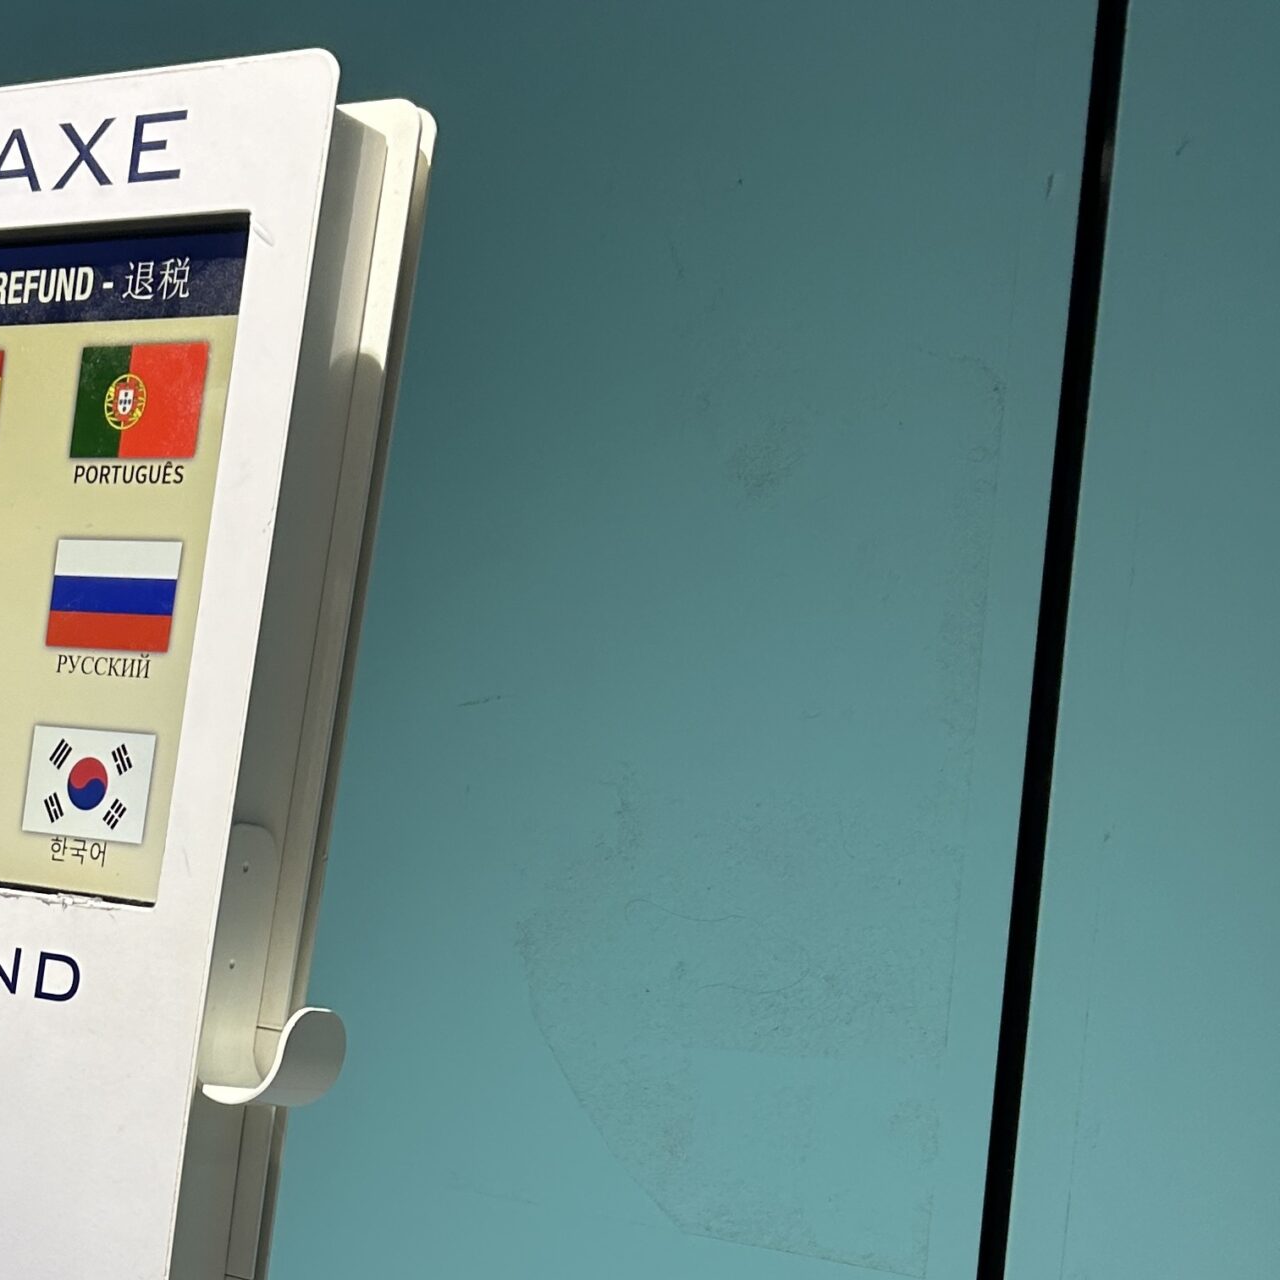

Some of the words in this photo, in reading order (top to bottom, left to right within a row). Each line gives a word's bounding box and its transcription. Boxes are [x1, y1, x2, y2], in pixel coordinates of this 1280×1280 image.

[122, 257, 191, 301] 退税
[73, 461, 184, 484] PORTUGUÊS
[56, 653, 151, 679] РУССКИЙ
[50, 837, 107, 867] 한국어
